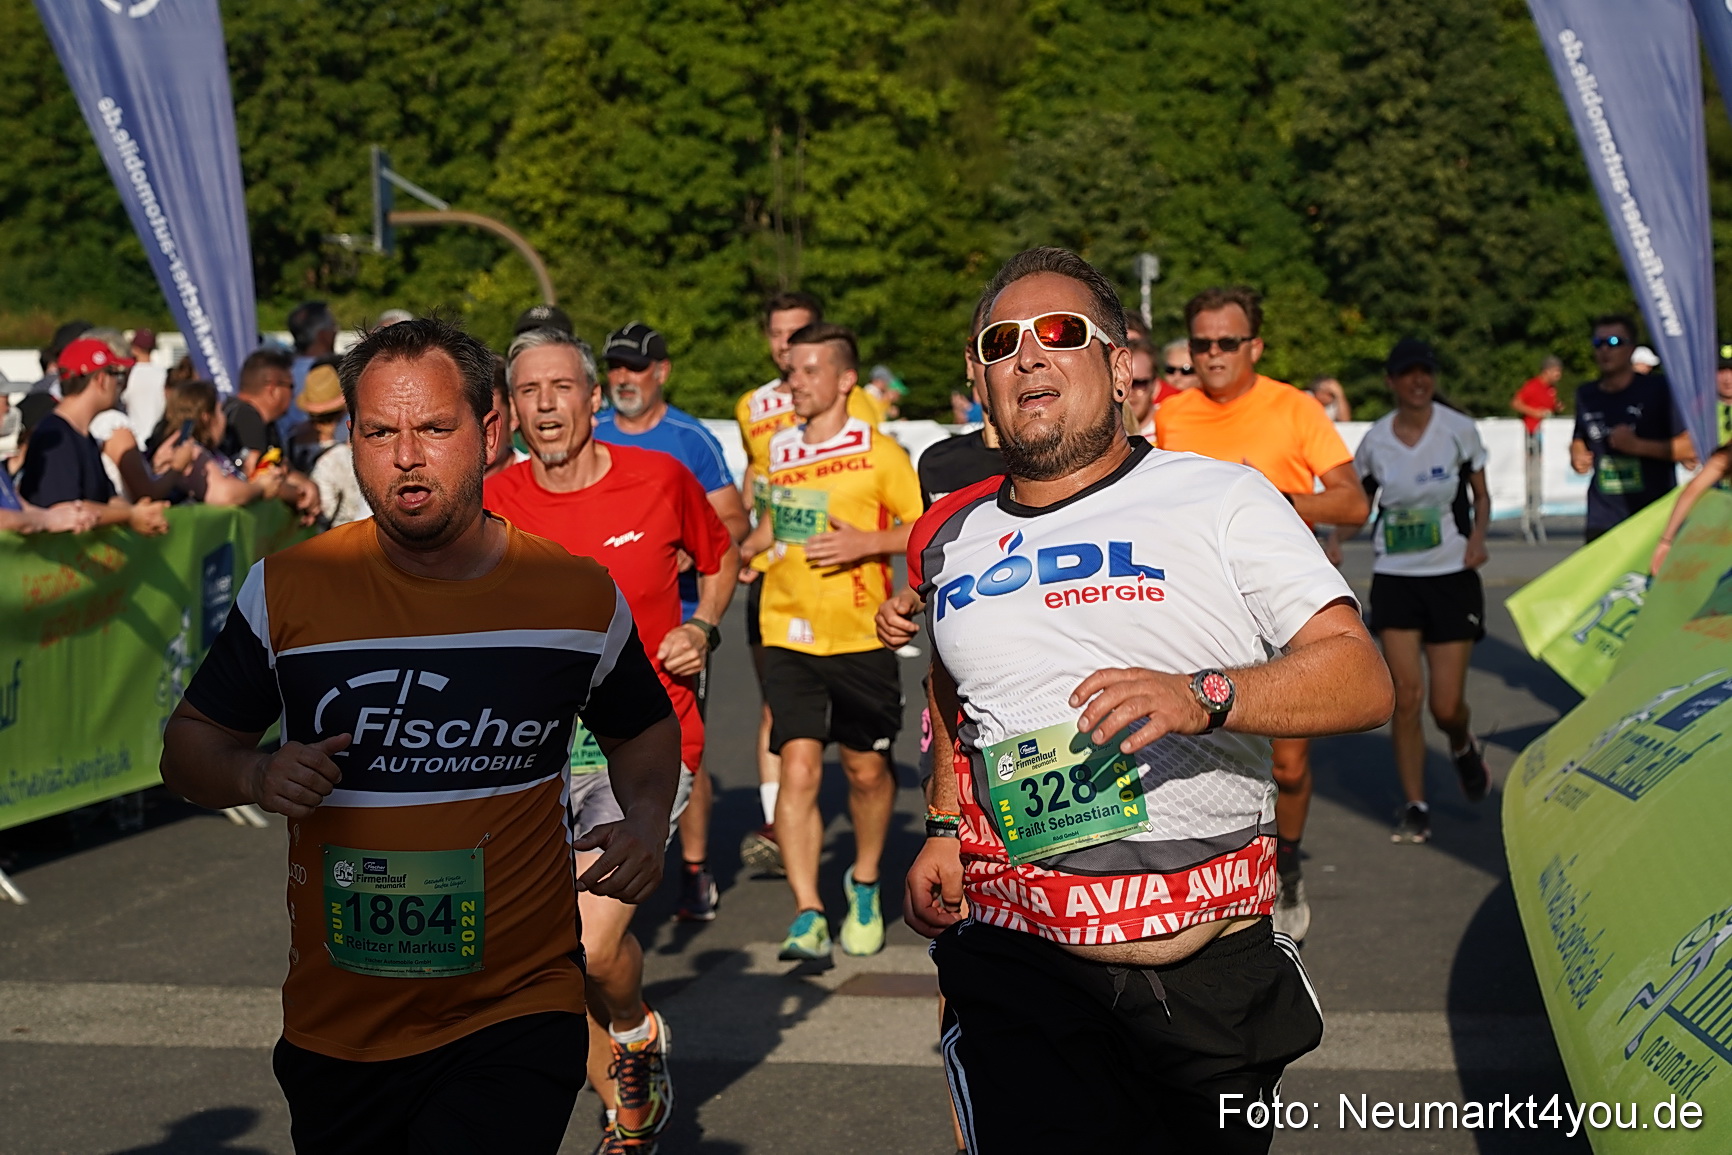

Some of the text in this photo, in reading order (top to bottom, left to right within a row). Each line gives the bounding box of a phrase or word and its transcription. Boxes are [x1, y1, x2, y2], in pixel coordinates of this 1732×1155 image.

[816, 457, 873, 478] BÖGL
[937, 529, 1166, 622] RÖDL
[352, 707, 560, 749] Fischer
[367, 754, 537, 774] AUTOMOBILE
[1015, 748, 1057, 770] Firmenlauf
[1031, 757, 1058, 770] neumarkt
[1020, 764, 1097, 818] 328
[1113, 760, 1139, 818] 2022
[999, 799, 1019, 842] RUN
[1017, 821, 1047, 840] Faißt
[1048, 804, 1121, 831] Sebastian
[1064, 831, 1080, 839] GmbH
[356, 873, 408, 884] Firmenlauf
[1065, 874, 1173, 918] AVIA
[1185, 853, 1251, 903] AVIA
[331, 902, 344, 945] RUN
[345, 892, 457, 936] 1864
[461, 900, 476, 957] 2022
[346, 935, 456, 955] Reitzer Markus
[365, 957, 383, 965] Fischer
[1641, 1035, 1718, 1101] neumarkt
